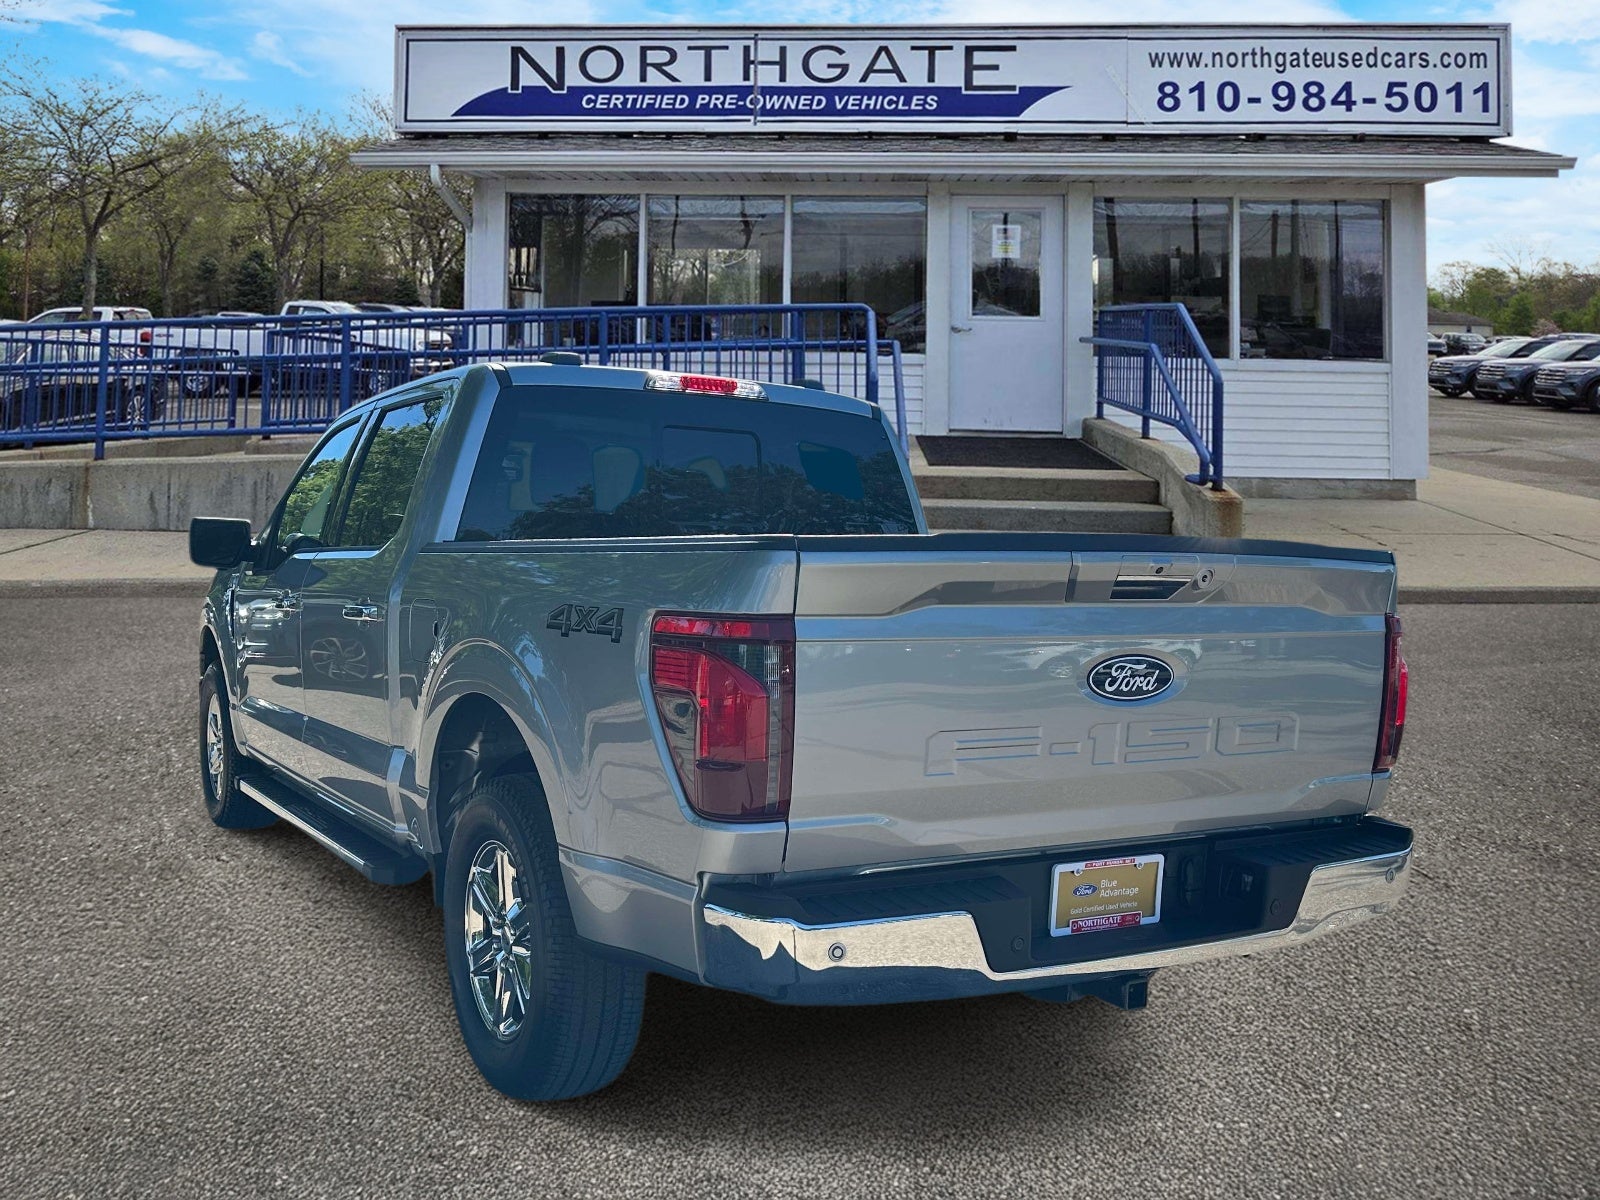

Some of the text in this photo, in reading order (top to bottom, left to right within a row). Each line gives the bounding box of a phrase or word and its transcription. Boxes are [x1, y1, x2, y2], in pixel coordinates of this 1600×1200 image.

[510, 45, 1017, 93] NORTHGATE
[1148, 47, 1489, 74] www.northgateusedcars.com
[581, 93, 938, 111] CERTIFIED PRE-OWNED VEHICLES
[1157, 80, 1491, 113] 810-984-5011
[1104, 661, 1160, 693] Ford
[924, 711, 1300, 777] F-150
[1076, 885, 1094, 896] Ford
[1100, 879, 1118, 888] Blue
[1100, 887, 1139, 898] Advantage
[1070, 901, 1138, 915] Gold Certified Used Vehicle
[1077, 915, 1122, 928] NORTHGATE
